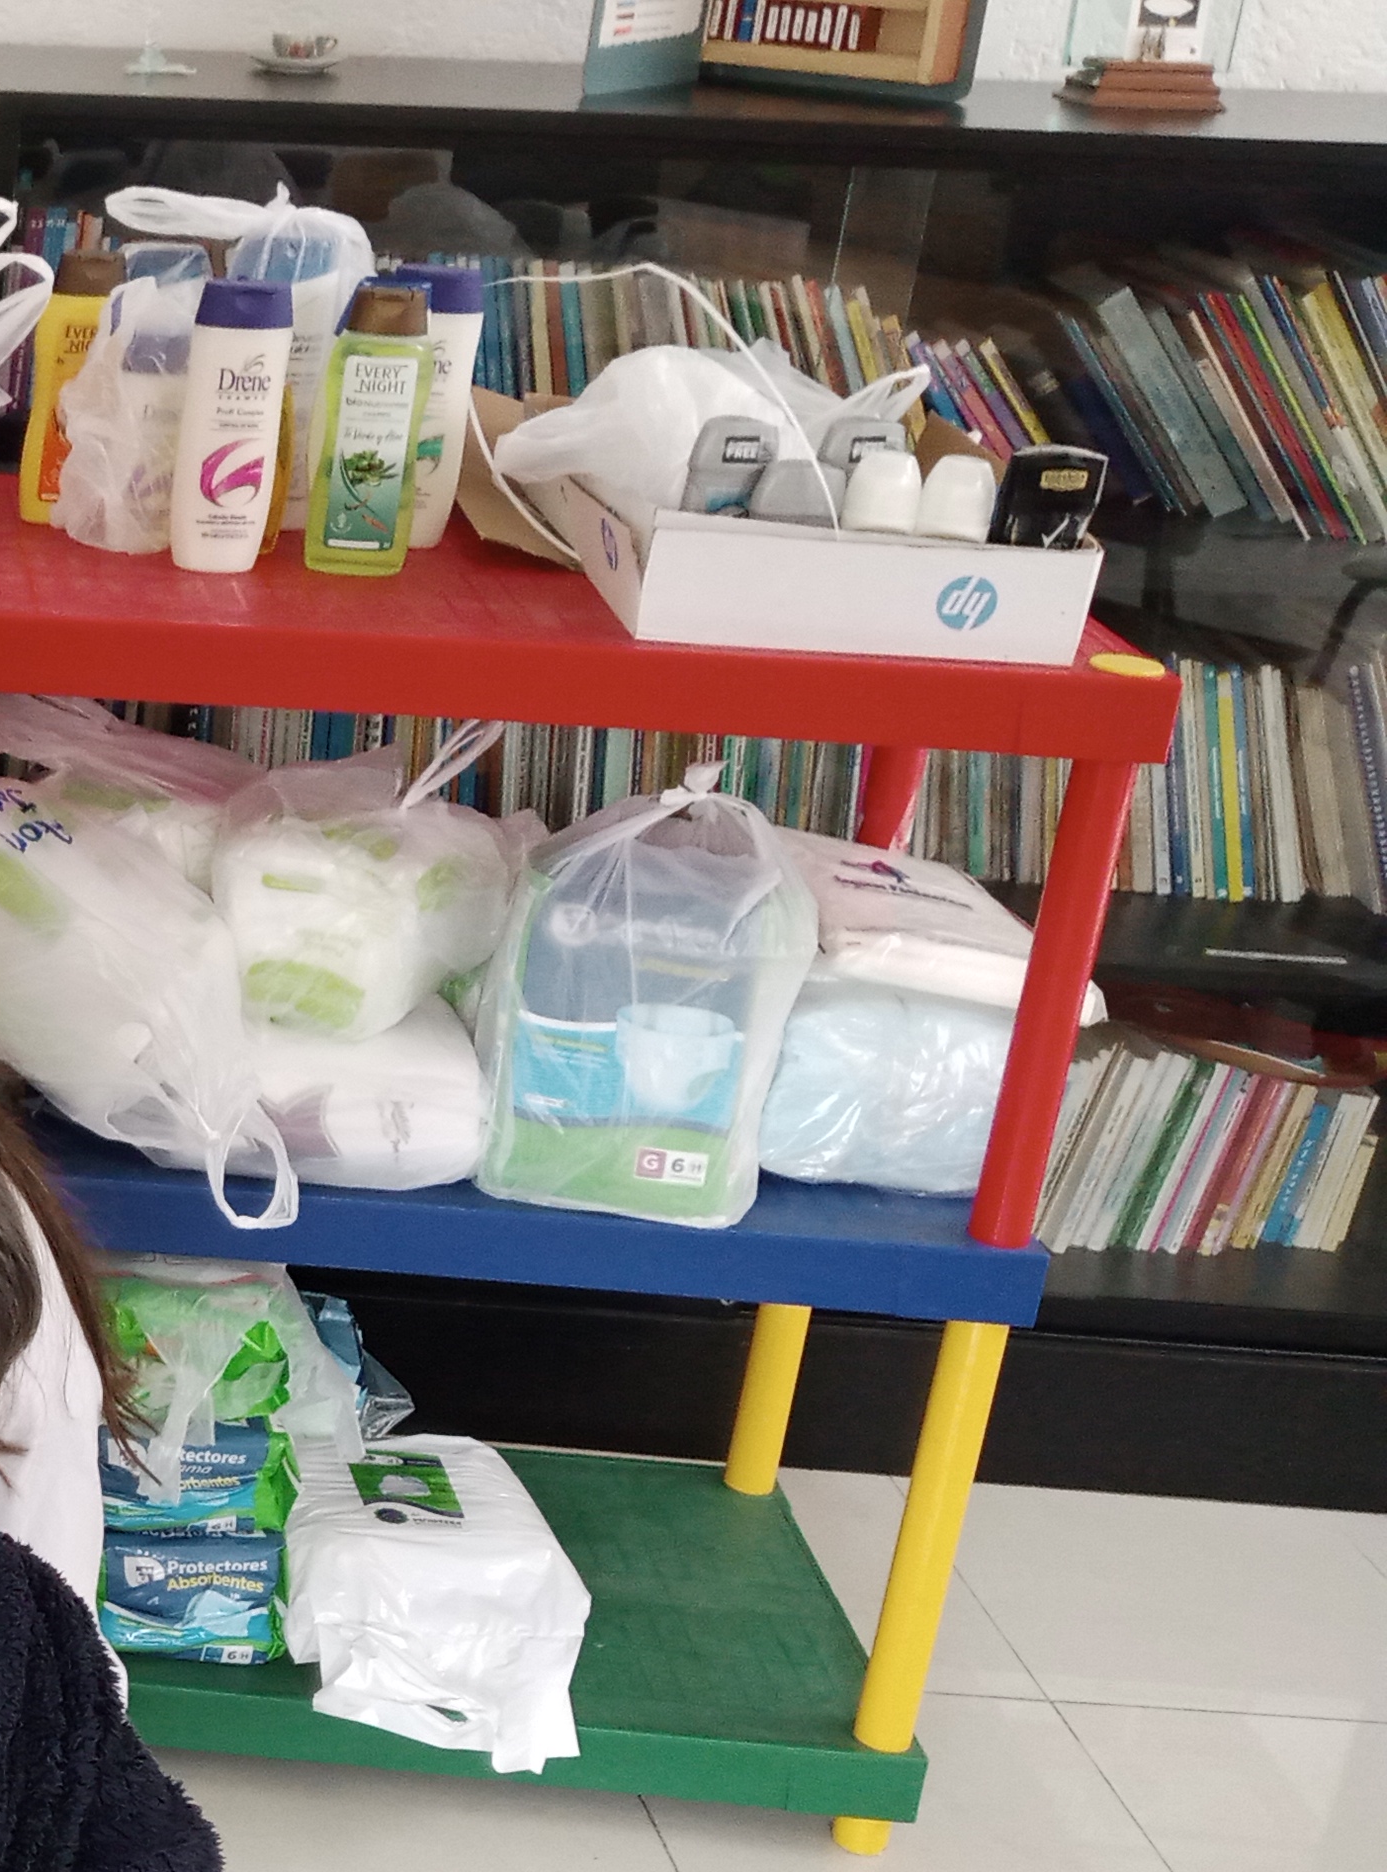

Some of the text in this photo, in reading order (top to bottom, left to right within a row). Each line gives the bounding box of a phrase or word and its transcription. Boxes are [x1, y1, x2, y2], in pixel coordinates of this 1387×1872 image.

[355, 362, 402, 379] EVERY
[218, 368, 271, 392] Drene
[359, 379, 406, 395] NIGHT
[643, 1154, 659, 1170] G
[671, 1158, 685, 1173] 6
[179, 1450, 247, 1465] tectores
[178, 1476, 241, 1491] orbentes
[166, 1559, 268, 1575] Protectores
[166, 1573, 264, 1594] Absorbentes
[227, 1649, 237, 1660] 6
